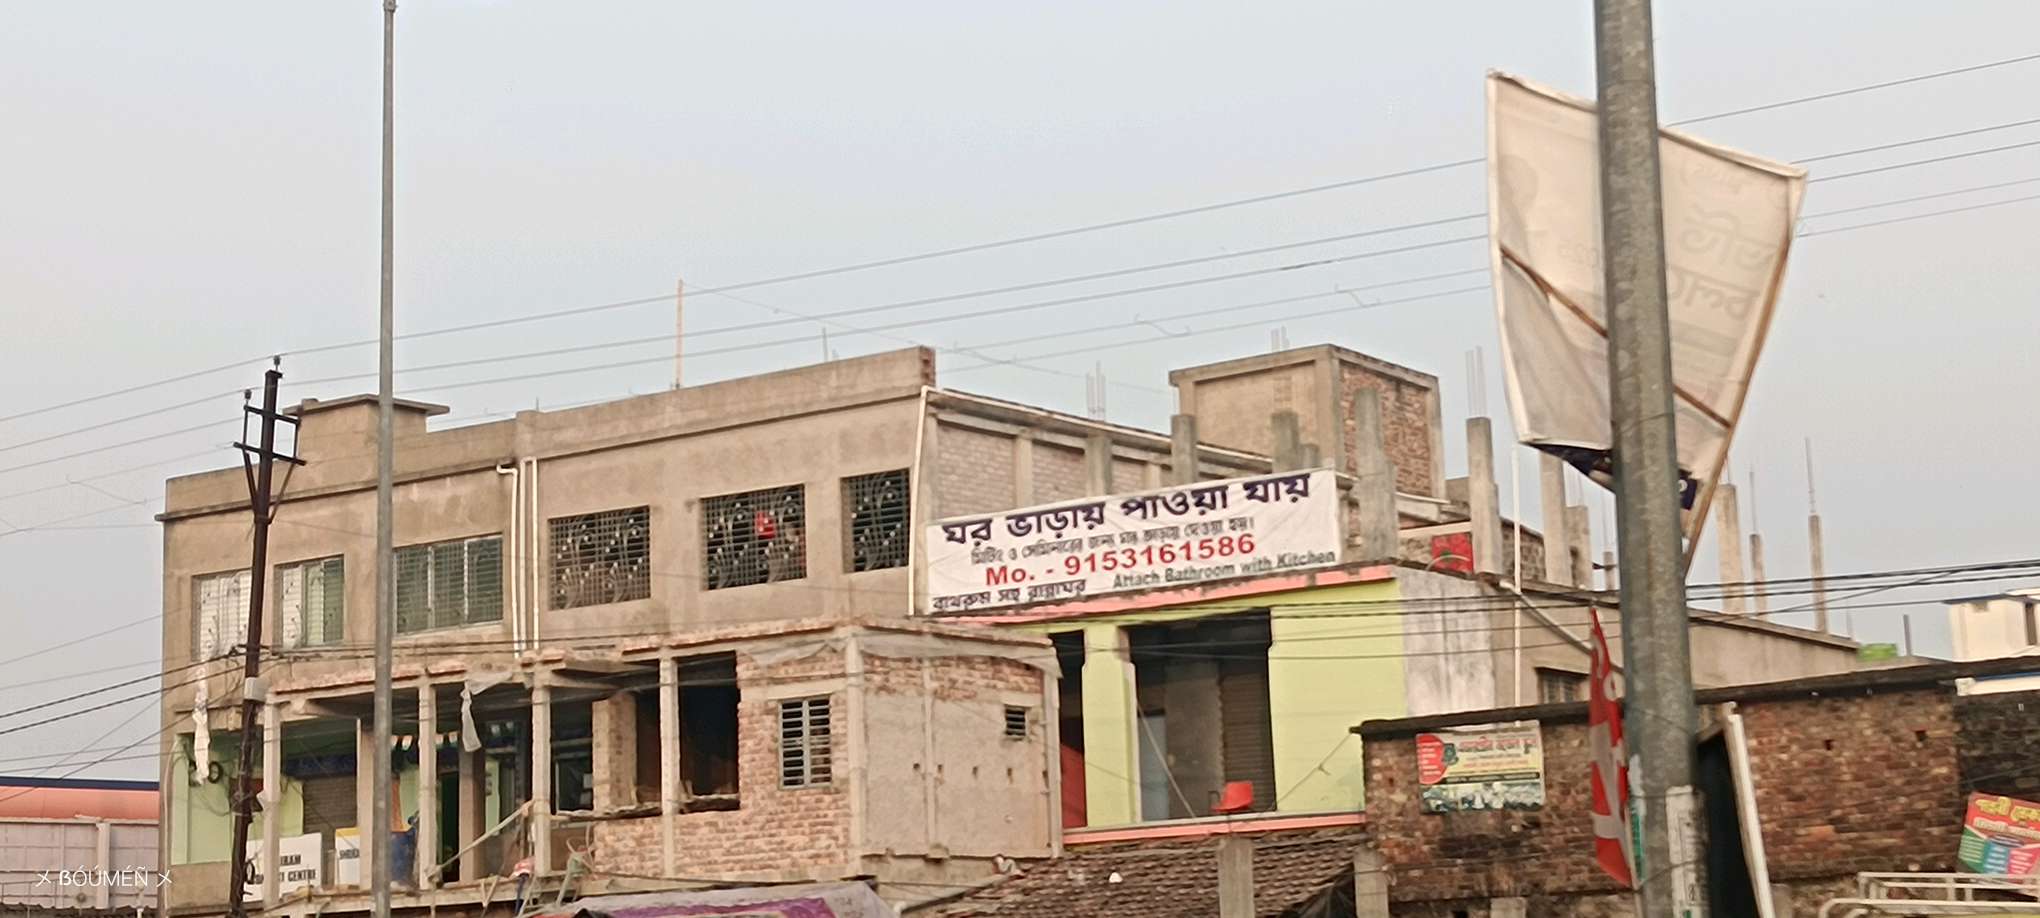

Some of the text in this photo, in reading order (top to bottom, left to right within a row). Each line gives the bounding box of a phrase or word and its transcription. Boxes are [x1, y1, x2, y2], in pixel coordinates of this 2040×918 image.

[942, 473, 1311, 547] ঘর ভাড়ায় পাওয়া যায়
[986, 565, 1035, 586] Mo.
[1064, 533, 1255, 576] 9153161586
[1113, 550, 1335, 589] Attach Bathroom with Kitchen
[933, 591, 991, 610] বাথরুম
[997, 588, 1020, 603] সহ
